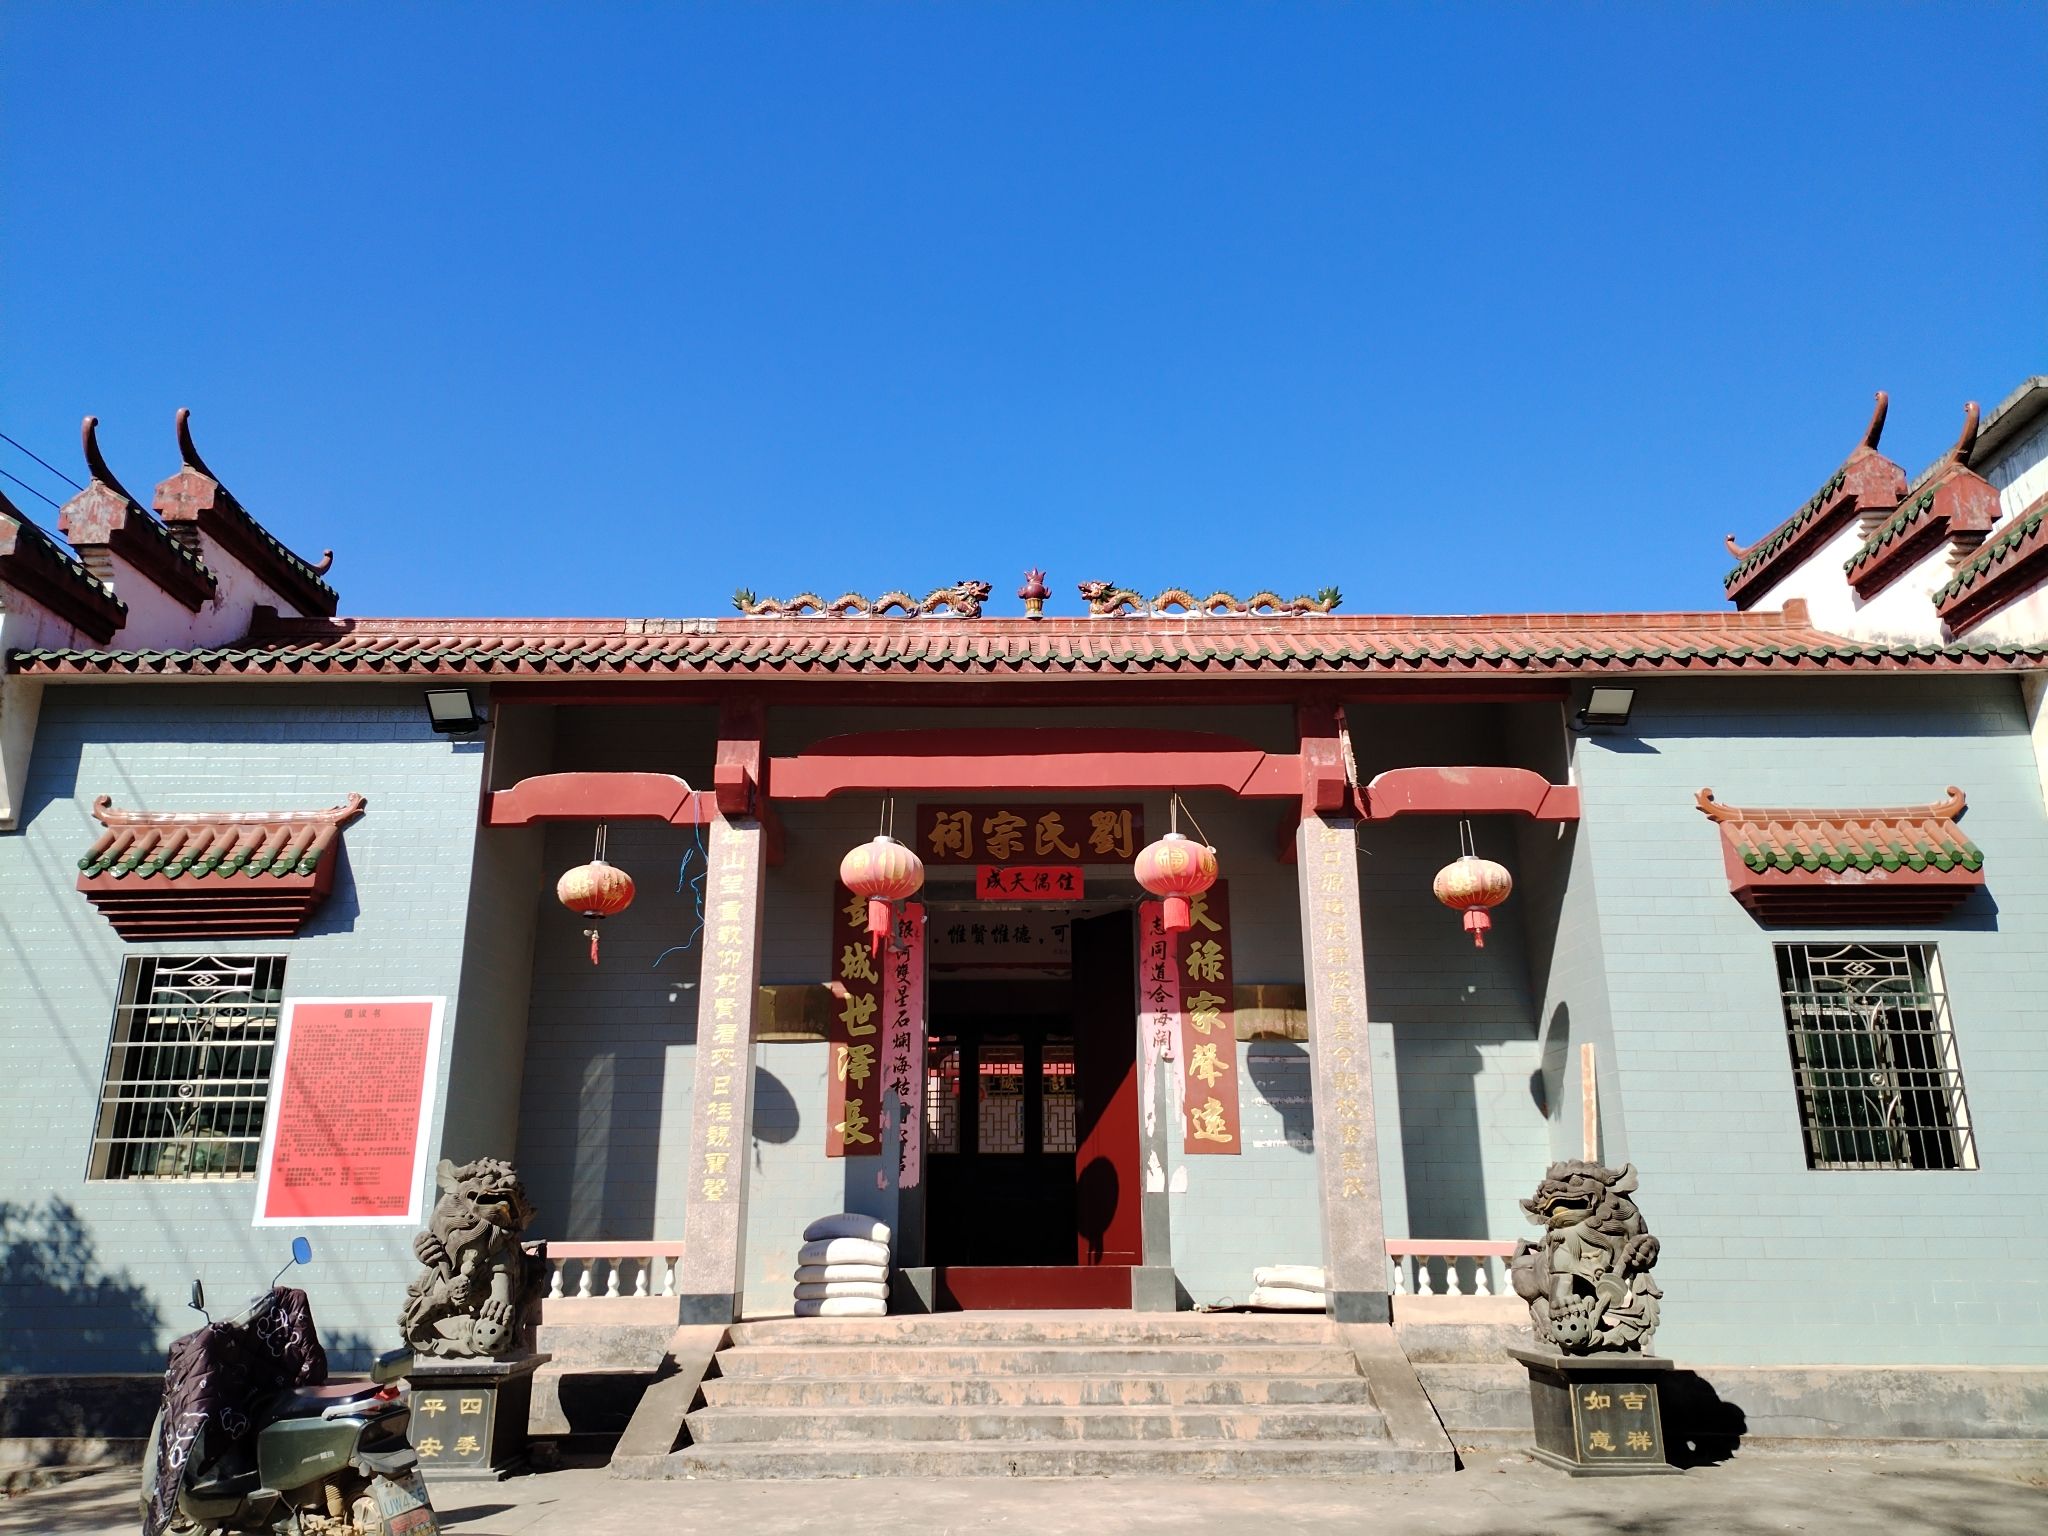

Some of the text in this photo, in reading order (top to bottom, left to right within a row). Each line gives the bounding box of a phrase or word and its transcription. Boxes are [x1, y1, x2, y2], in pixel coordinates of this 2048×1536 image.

[928, 809, 1134, 860] 劉氏宗祠
[985, 869, 1076, 894] 佳偶天成
[416, 1398, 448, 1458] 平安
[453, 1397, 483, 1457] 四季
[1583, 1390, 1617, 1452] 如意
[1619, 1391, 1653, 1451] 吉祥
